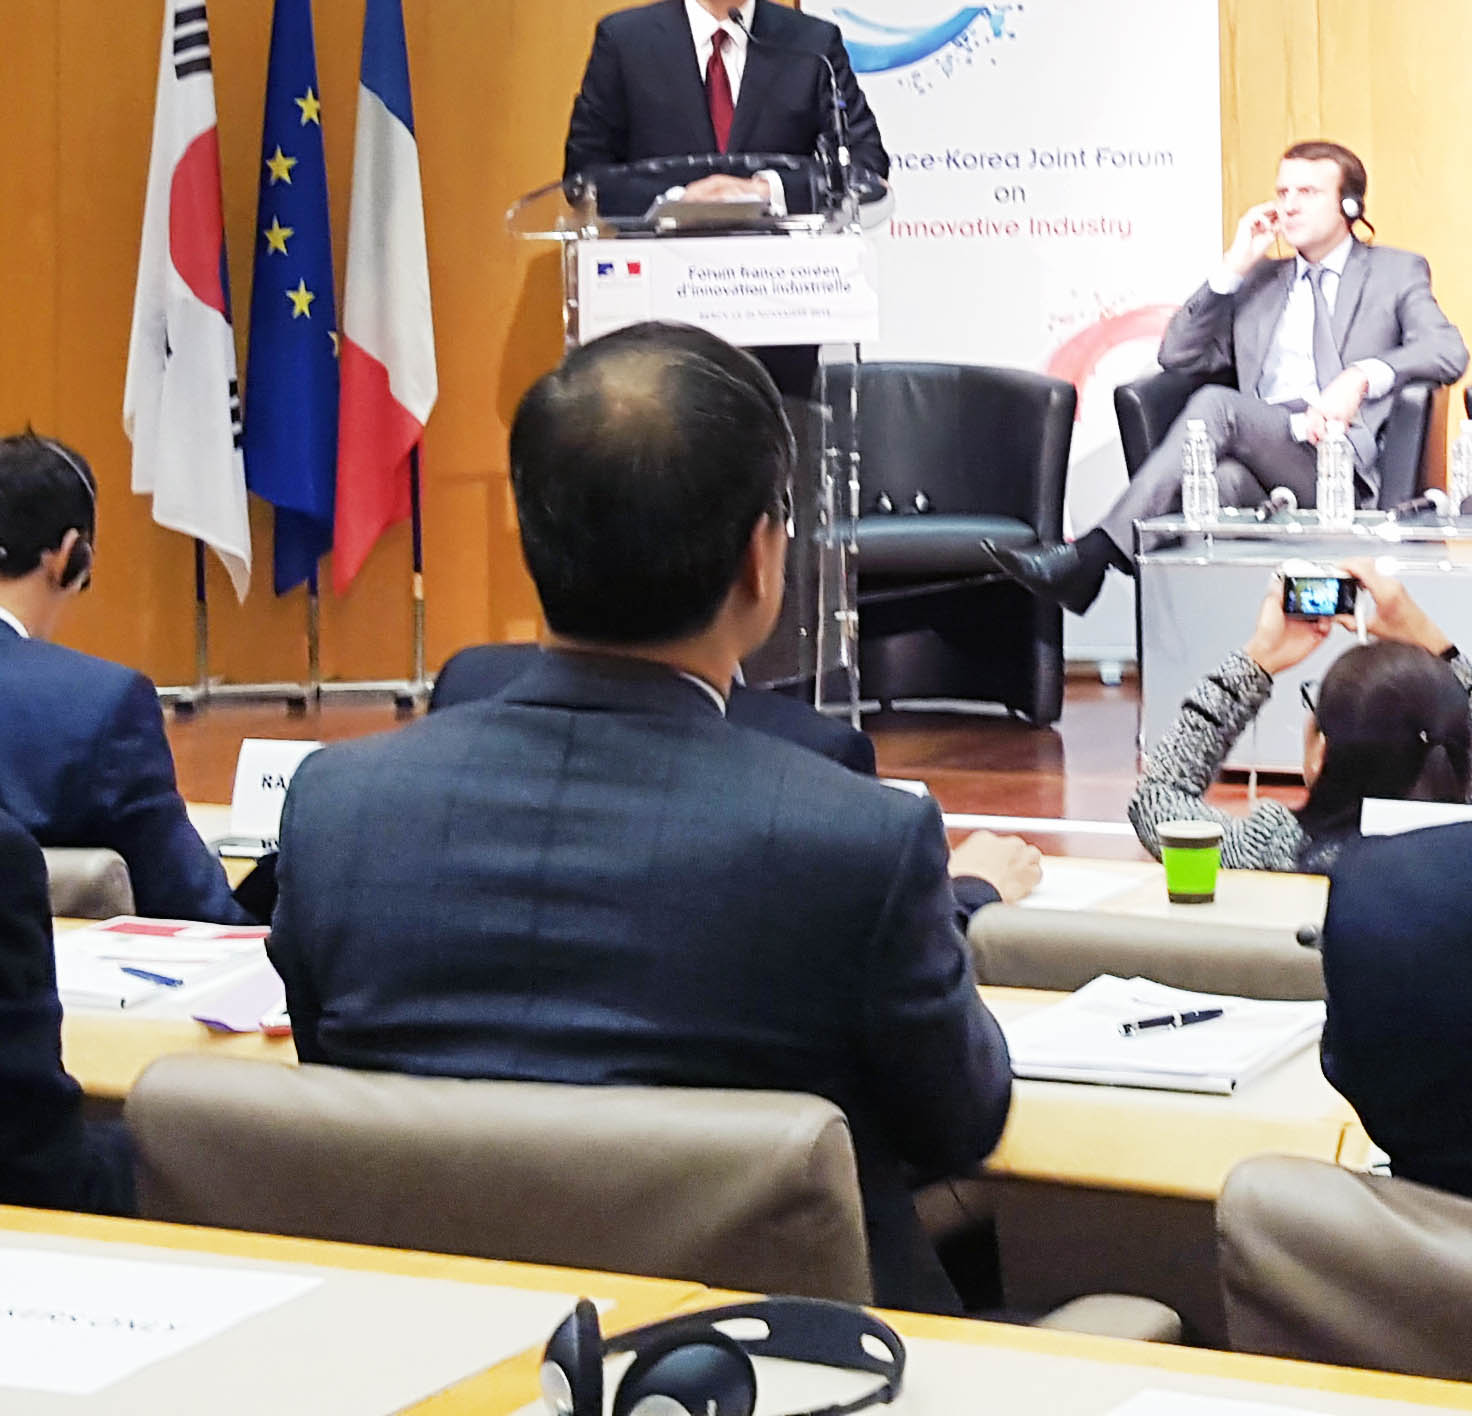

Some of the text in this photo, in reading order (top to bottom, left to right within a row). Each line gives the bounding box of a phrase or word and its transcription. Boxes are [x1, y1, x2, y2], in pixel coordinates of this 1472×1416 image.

[889, 146, 1174, 170] nce-Korea Joint Forum
[994, 185, 1026, 204] on
[890, 215, 1132, 241] Innovative Industry
